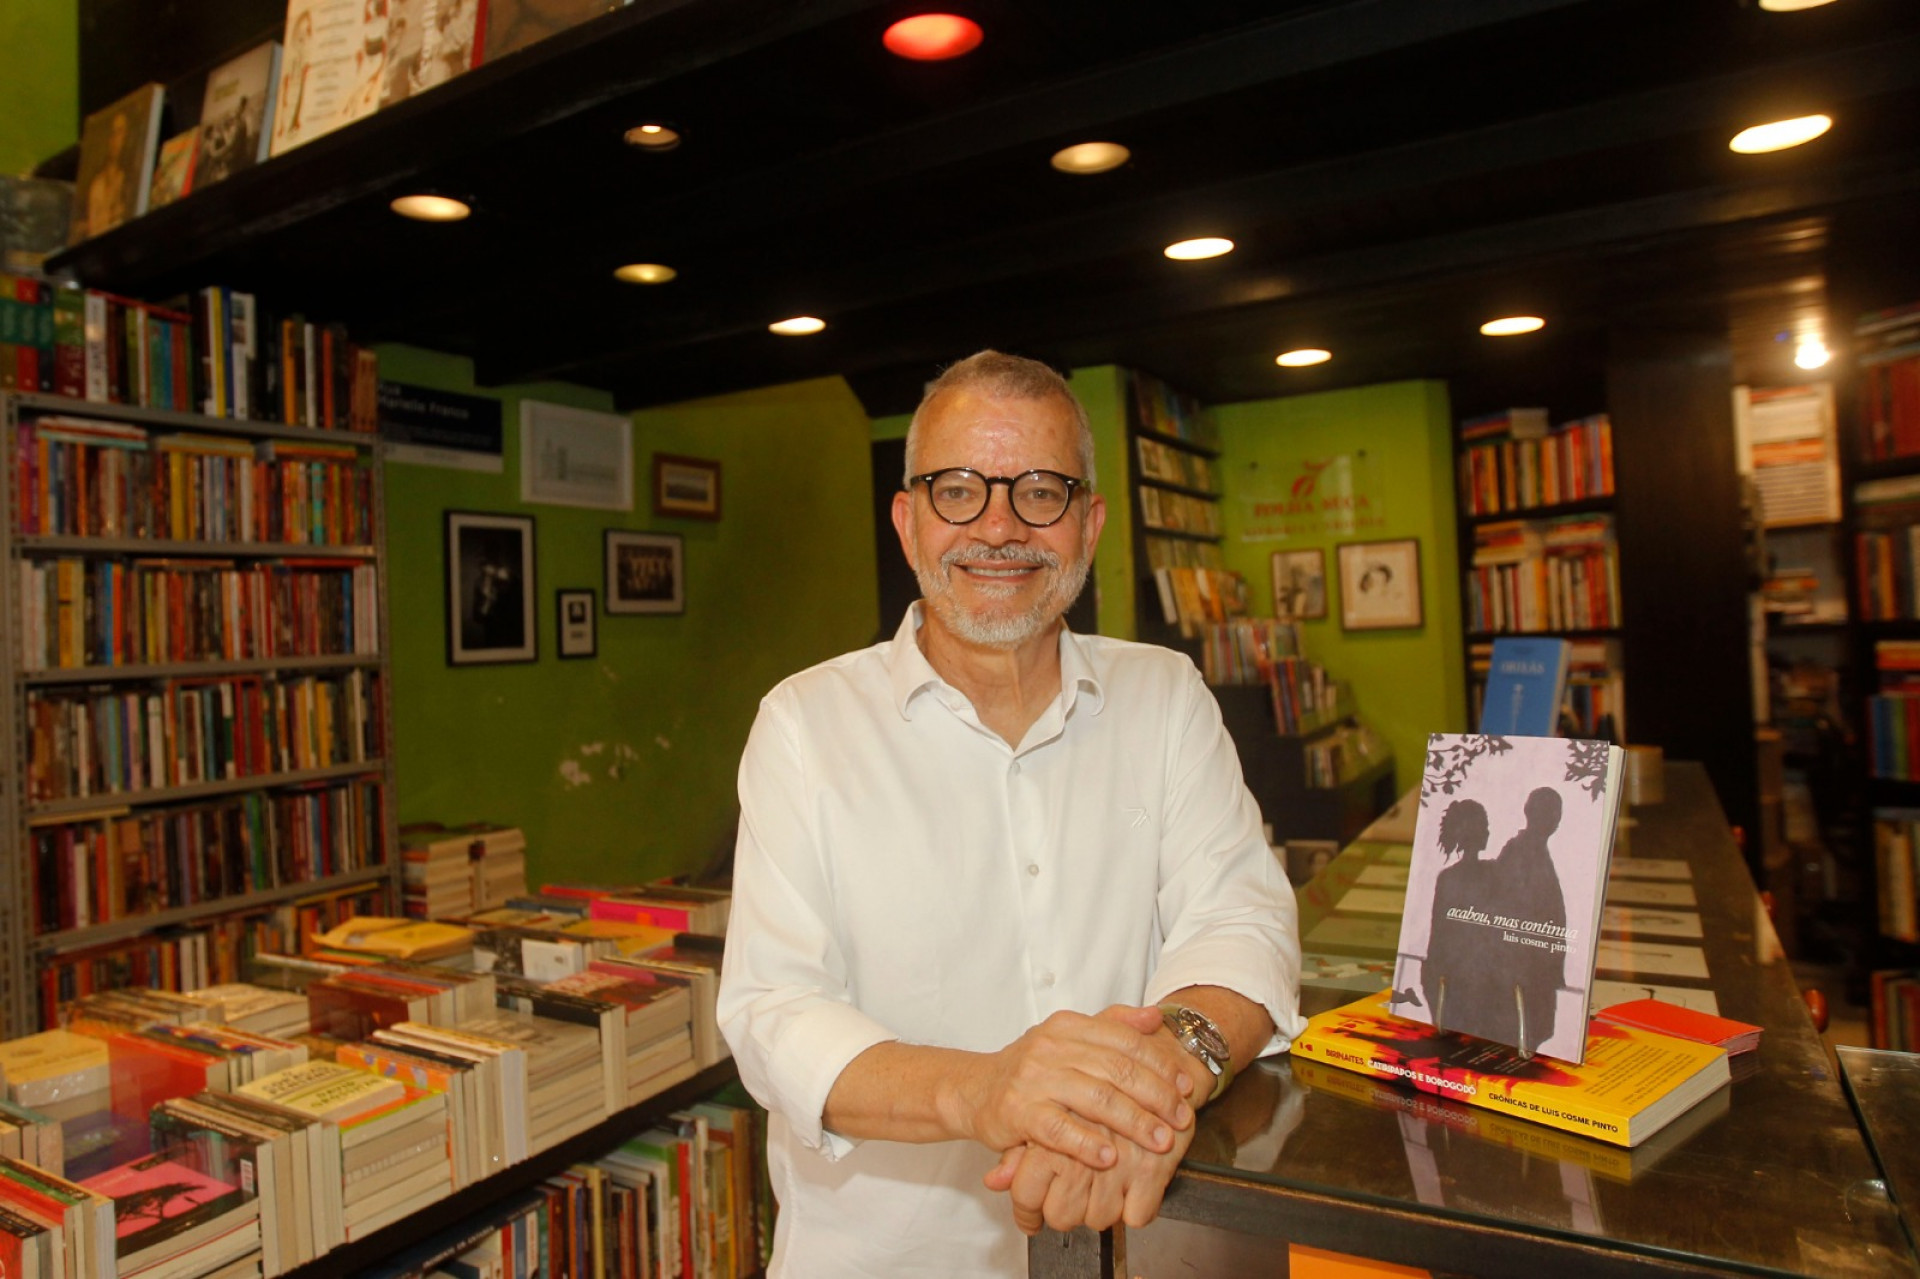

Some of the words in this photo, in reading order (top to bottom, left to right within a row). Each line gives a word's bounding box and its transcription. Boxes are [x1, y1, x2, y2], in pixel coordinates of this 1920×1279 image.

[1446, 905, 1490, 925] acabou,
[1493, 915, 1519, 929] mas
[1520, 920, 1579, 939] continua
[1503, 931, 1519, 943] luis
[1520, 936, 1549, 949] cosme
[1551, 941, 1577, 953] pinto
[1418, 1073, 1425, 1082] E
[1426, 1075, 1477, 1095] BOROGODÓ
[1489, 1092, 1528, 1109] CRÔNICAS
[1529, 1103, 1541, 1112] DE
[1541, 1107, 1560, 1118] LUIS
[1561, 1112, 1590, 1126] COSME
[1592, 1119, 1619, 1133] PINTO
